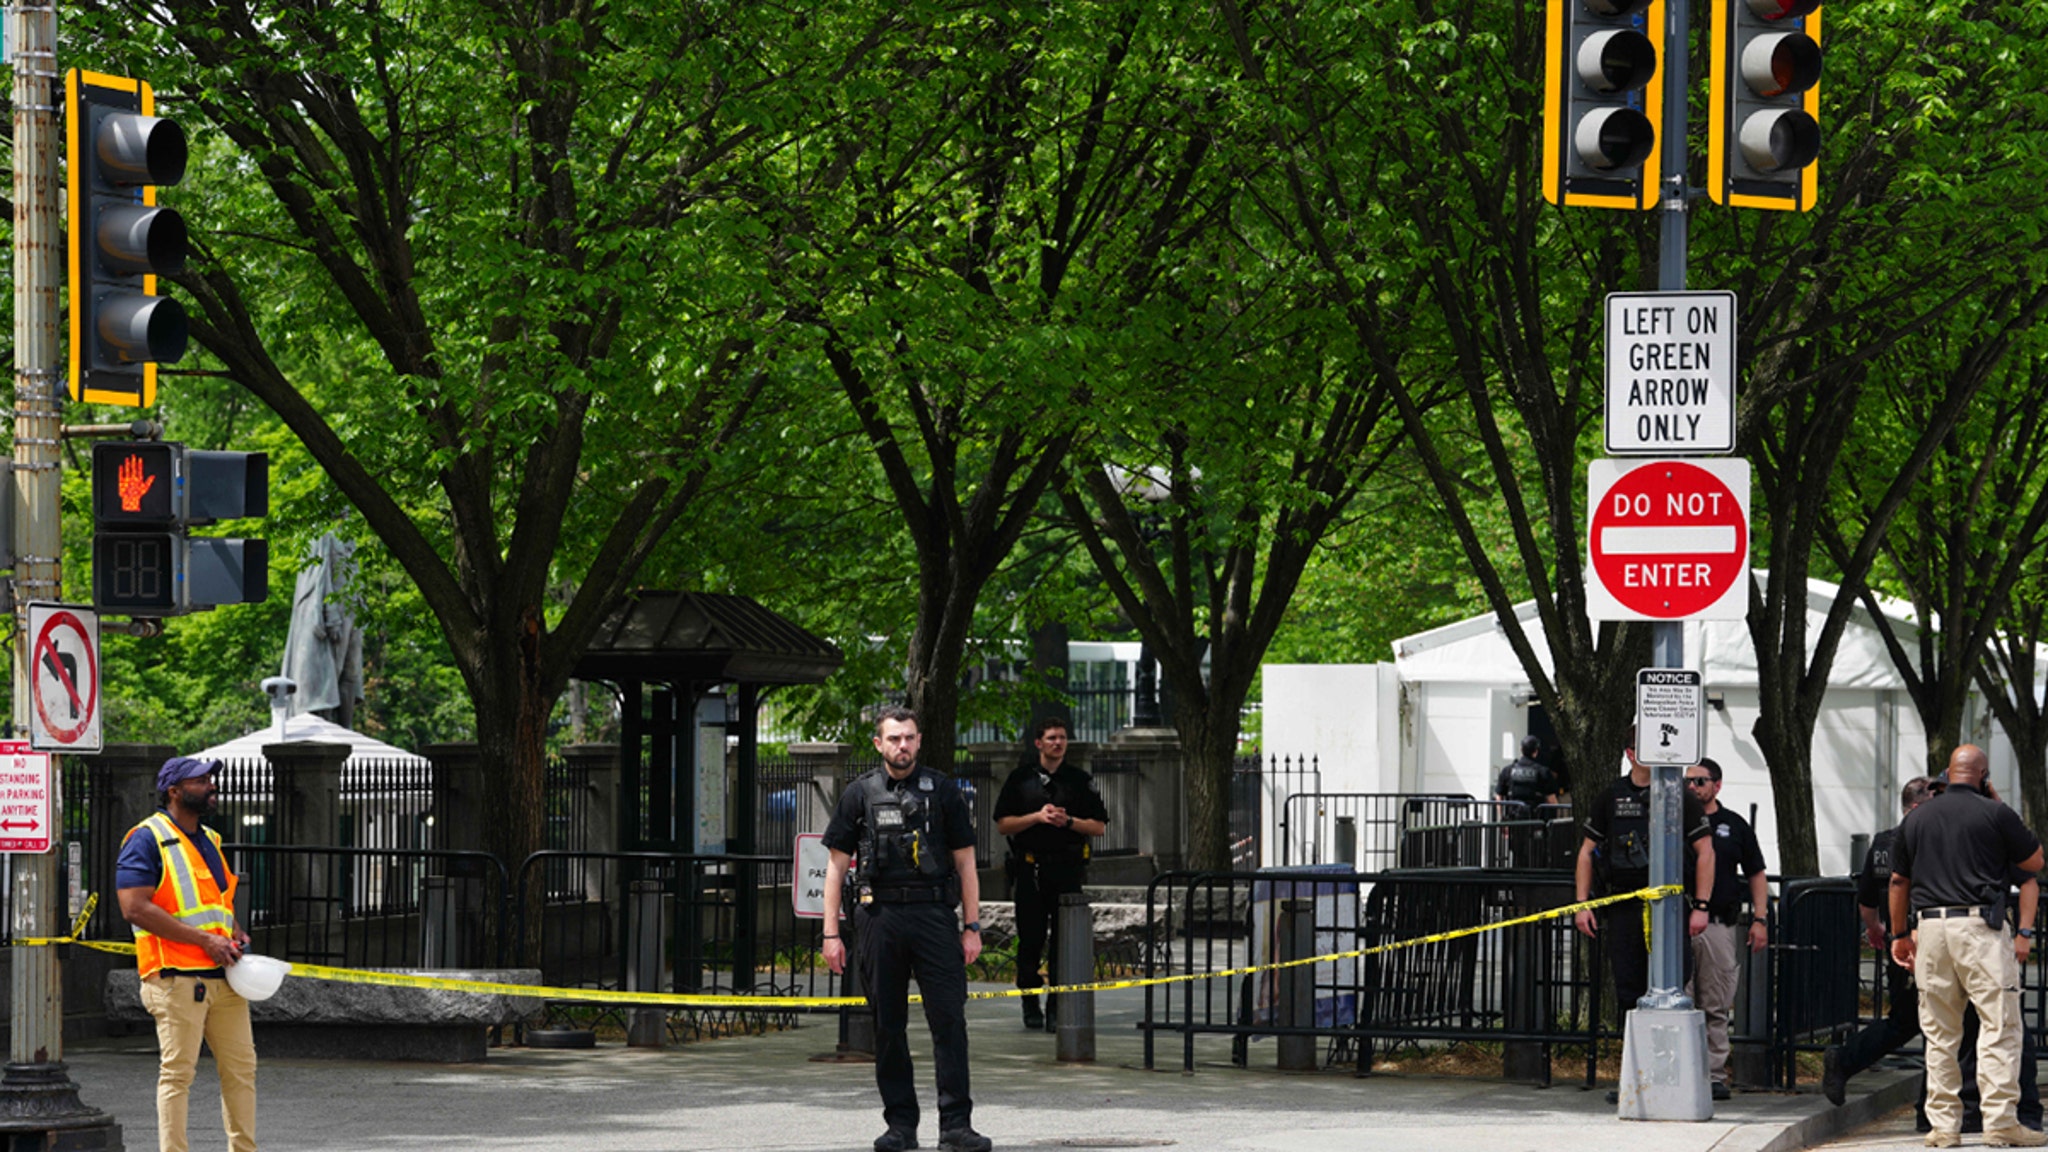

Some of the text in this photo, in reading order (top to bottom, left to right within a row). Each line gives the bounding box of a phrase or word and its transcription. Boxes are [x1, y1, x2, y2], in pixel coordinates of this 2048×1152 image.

[1623, 306, 1717, 335] LEFT ON
[1629, 342, 1709, 371] GREEN
[1628, 378, 1709, 406] ARROW
[1637, 413, 1701, 442] ONLY
[1614, 492, 1722, 517] DO NOT
[1624, 563, 1711, 587] ENTER
[1646, 673, 1692, 683] NOTICE
[14, 758, 26, 769] NO
[0, 774, 40, 785] STANDING
[7, 788, 44, 800] PARKING
[2, 804, 38, 816] ANYTIME
